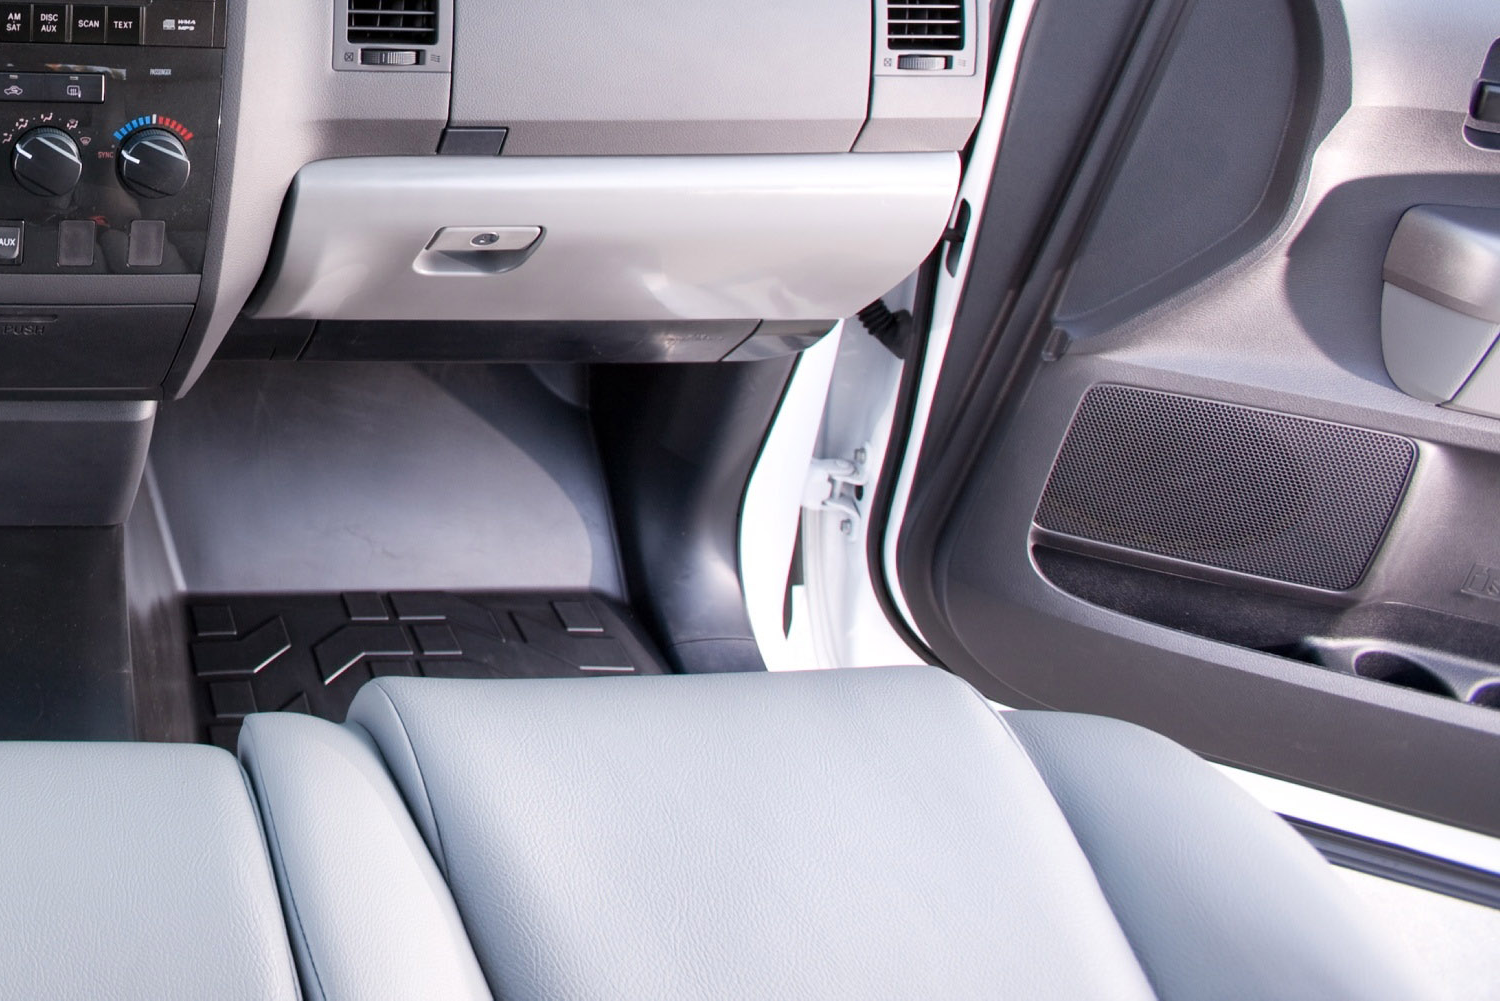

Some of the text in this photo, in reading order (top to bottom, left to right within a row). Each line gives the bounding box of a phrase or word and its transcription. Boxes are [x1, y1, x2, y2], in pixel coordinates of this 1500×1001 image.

[40, 13, 58, 21] DISC
[6, 23, 21, 31] SAT
[78, 19, 100, 28] SCAN
[113, 21, 133, 29] TEXT
[41, 24, 57, 32] AUX
[97, 151, 114, 159] SYNC
[3, 324, 46, 336] PUSH
